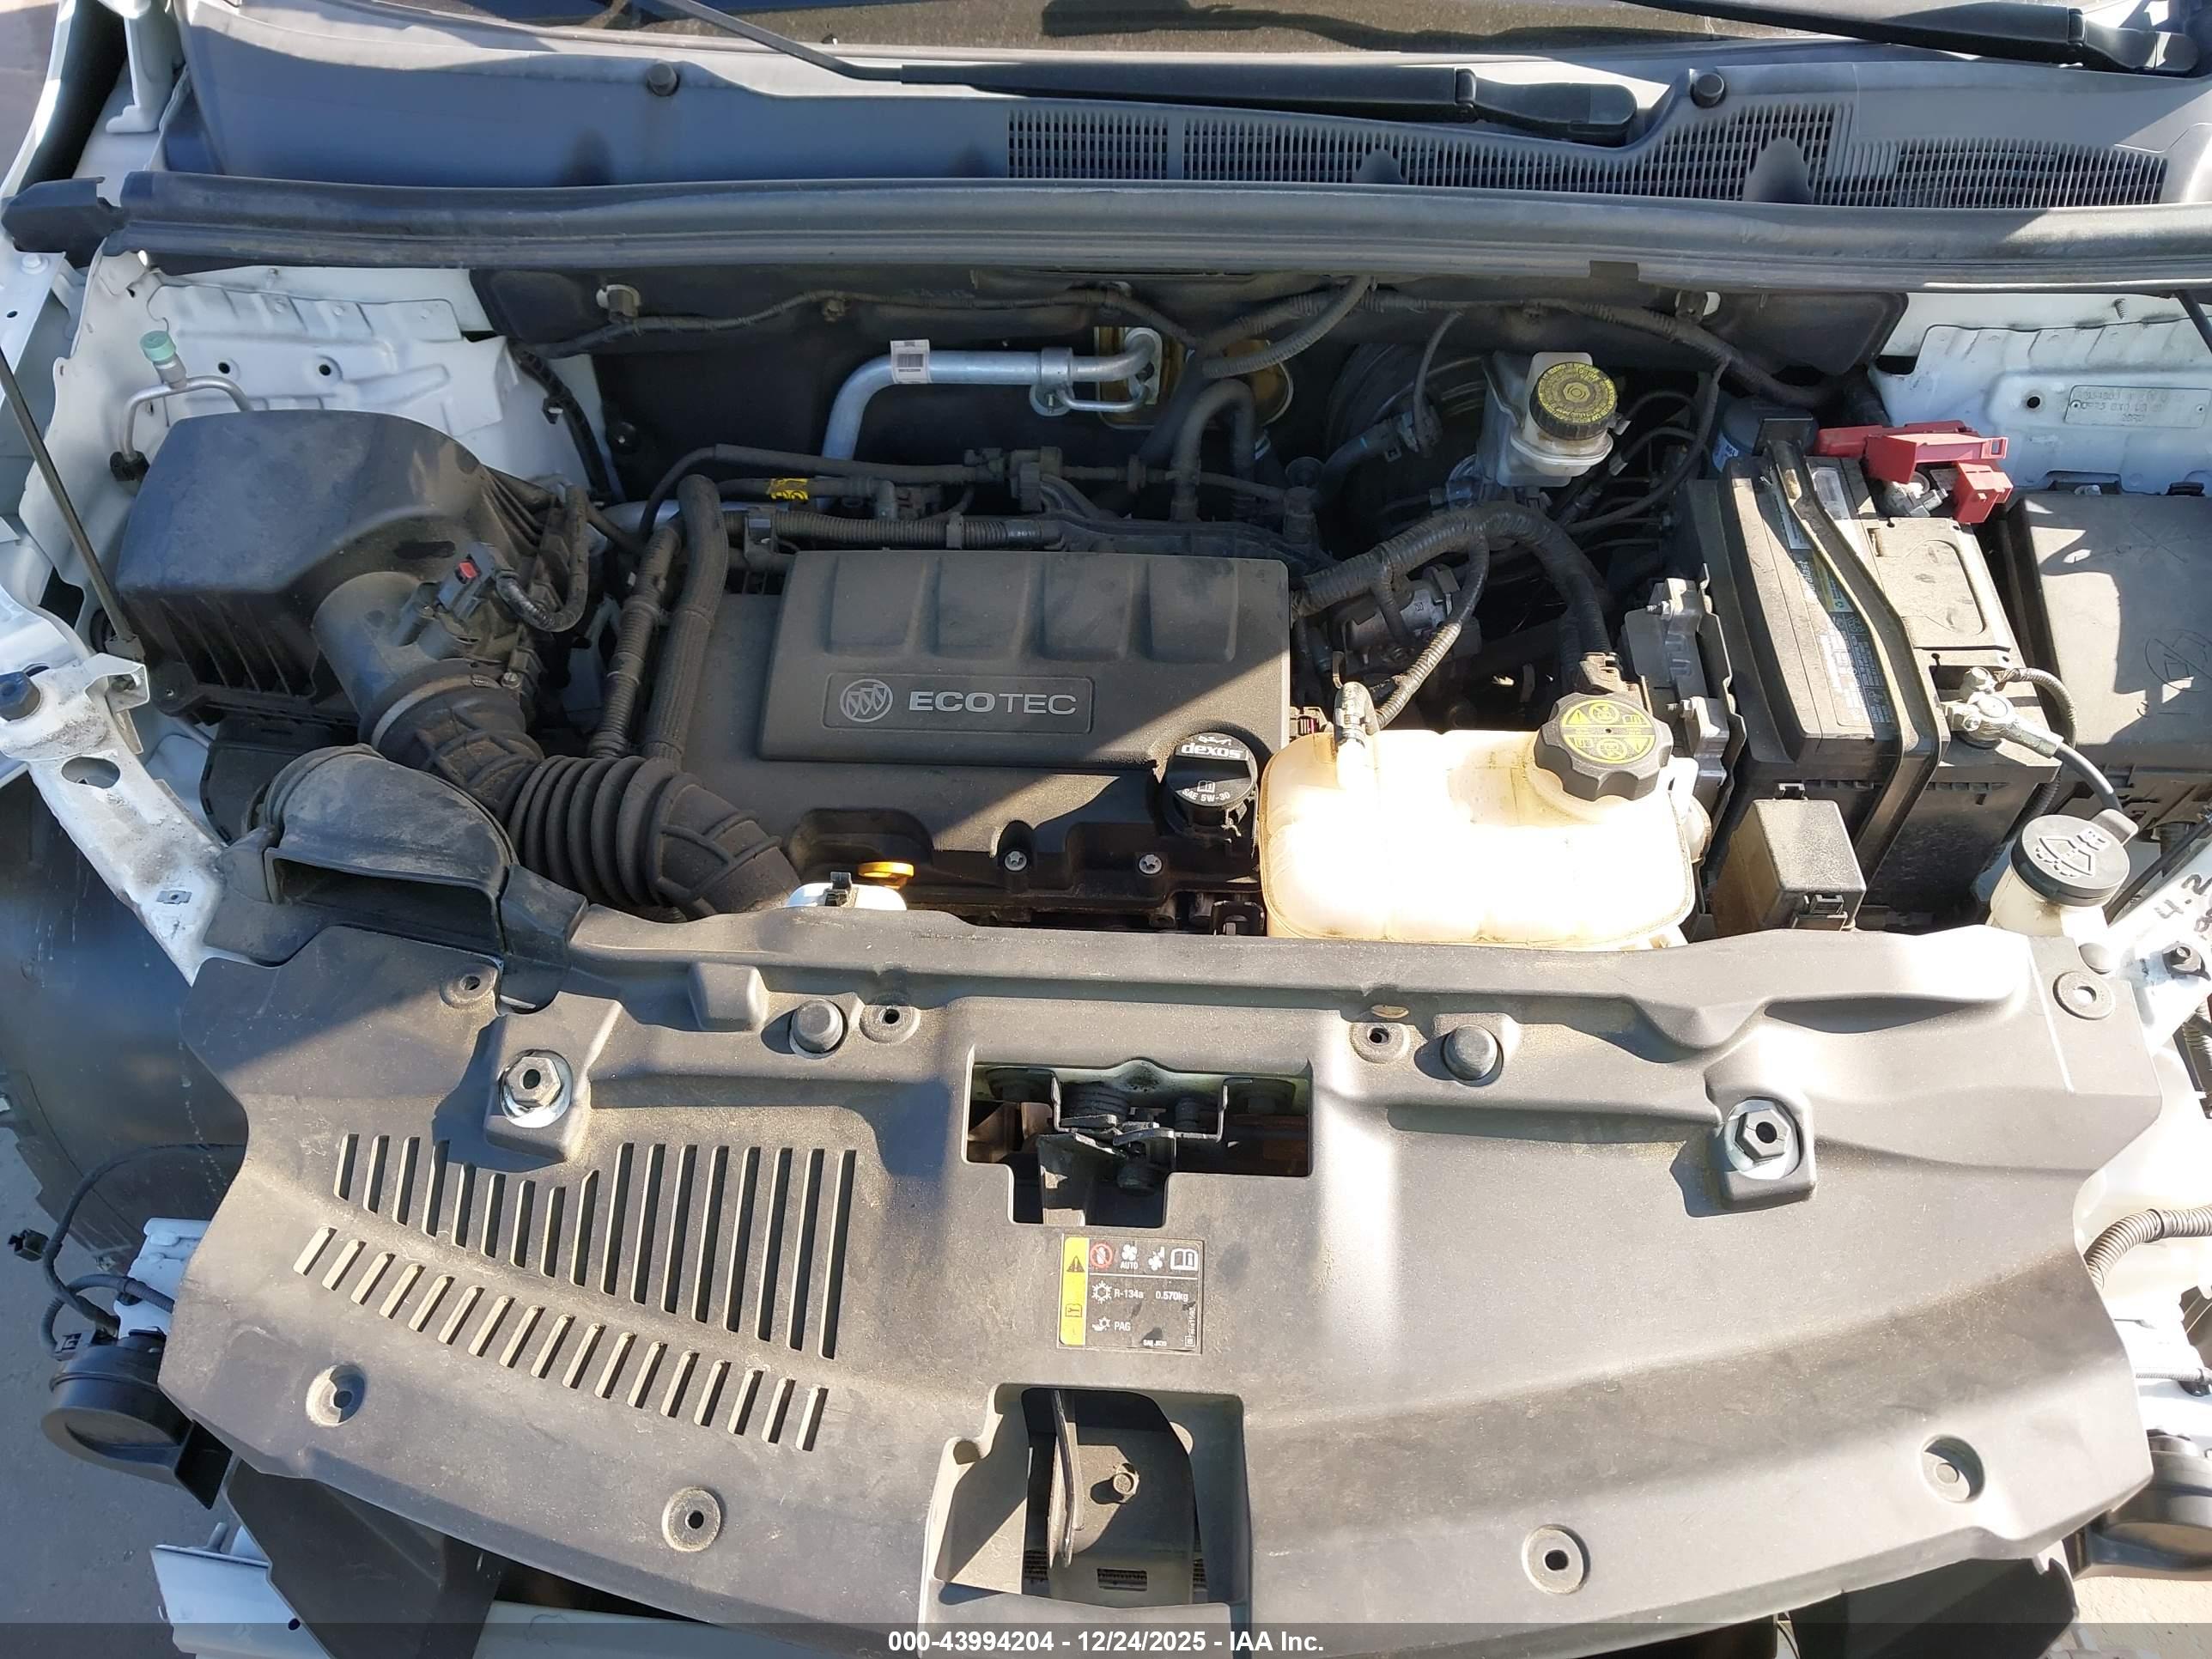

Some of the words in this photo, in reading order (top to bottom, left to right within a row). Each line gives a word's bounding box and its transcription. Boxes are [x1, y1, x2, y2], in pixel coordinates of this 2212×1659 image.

[1797, 560, 1816, 593] uralast
[908, 690, 1078, 715] ECOTEC
[1182, 743, 1243, 758] dexos
[1182, 788, 1199, 800] SAE
[1200, 791, 1231, 802] 5W-30
[1120, 1261, 1139, 1270] AUTO
[1114, 1288, 1145, 1299] R-134a
[1155, 1290, 1189, 1302] 0.570kg
[1114, 1321, 1132, 1332] PAG
